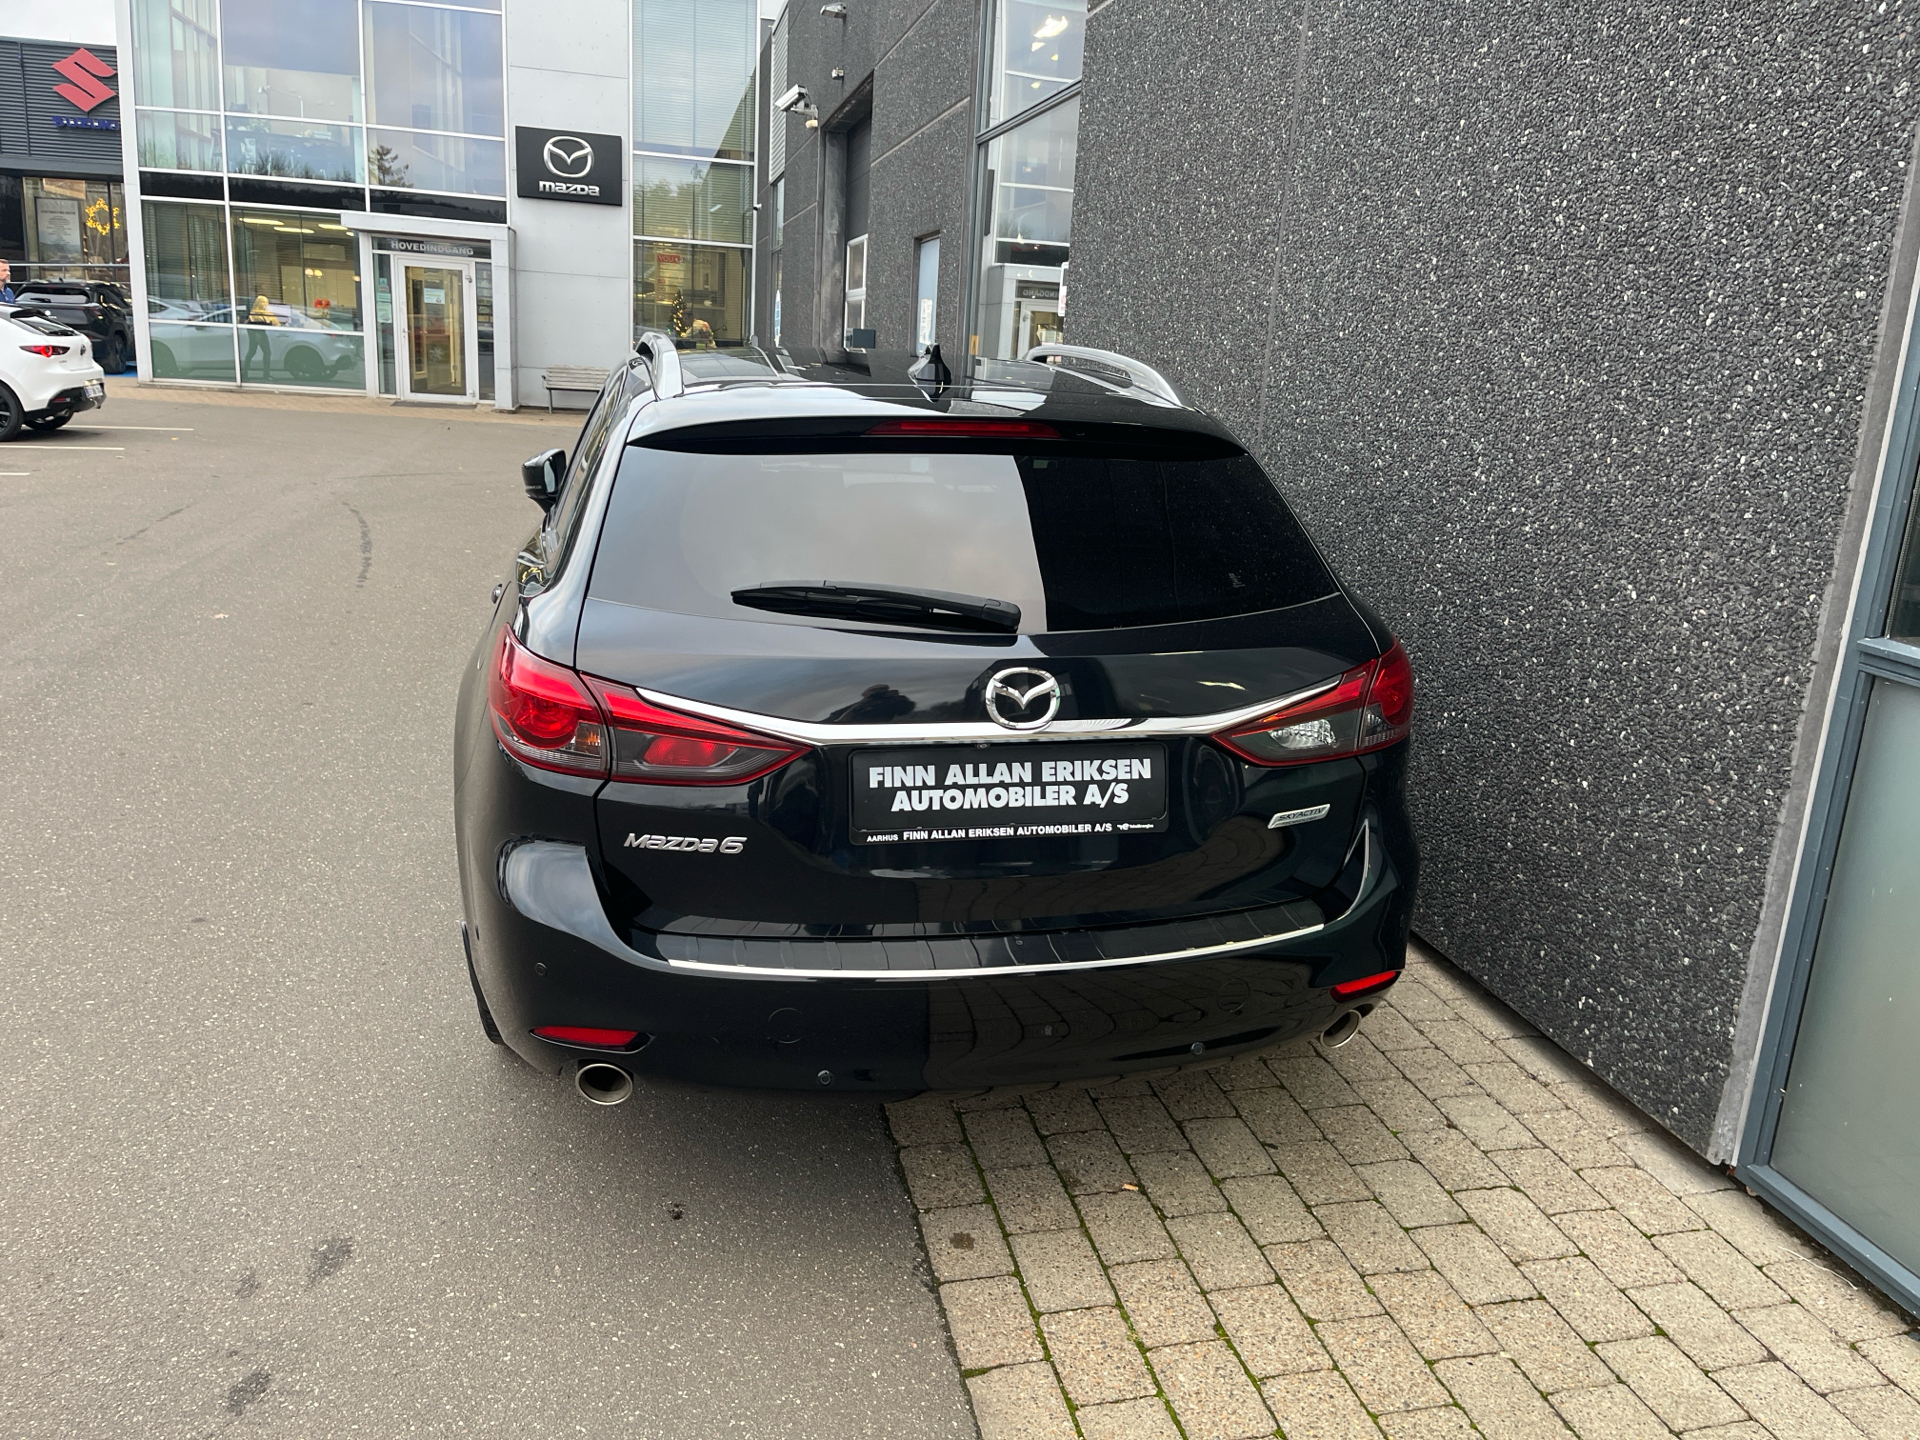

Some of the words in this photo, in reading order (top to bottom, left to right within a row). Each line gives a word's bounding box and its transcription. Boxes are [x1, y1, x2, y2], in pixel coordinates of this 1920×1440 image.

[391, 240, 474, 255] HOVEDINDGANG
[869, 765, 935, 788] FINN
[944, 761, 1032, 786] ALLAN
[1041, 758, 1151, 782] ERIKSEN
[891, 783, 1076, 812] AUTOMOBILER
[1083, 782, 1129, 808] A/S
[1279, 808, 1325, 820] SKYACTIV
[866, 834, 899, 842] AARHUS
[903, 830, 928, 841] FINN
[930, 829, 966, 839] ALLAN
[968, 826, 1014, 838] ERIKSEN
[1016, 823, 1092, 836] AUTOMOBILER
[1093, 822, 1113, 832] A/S
